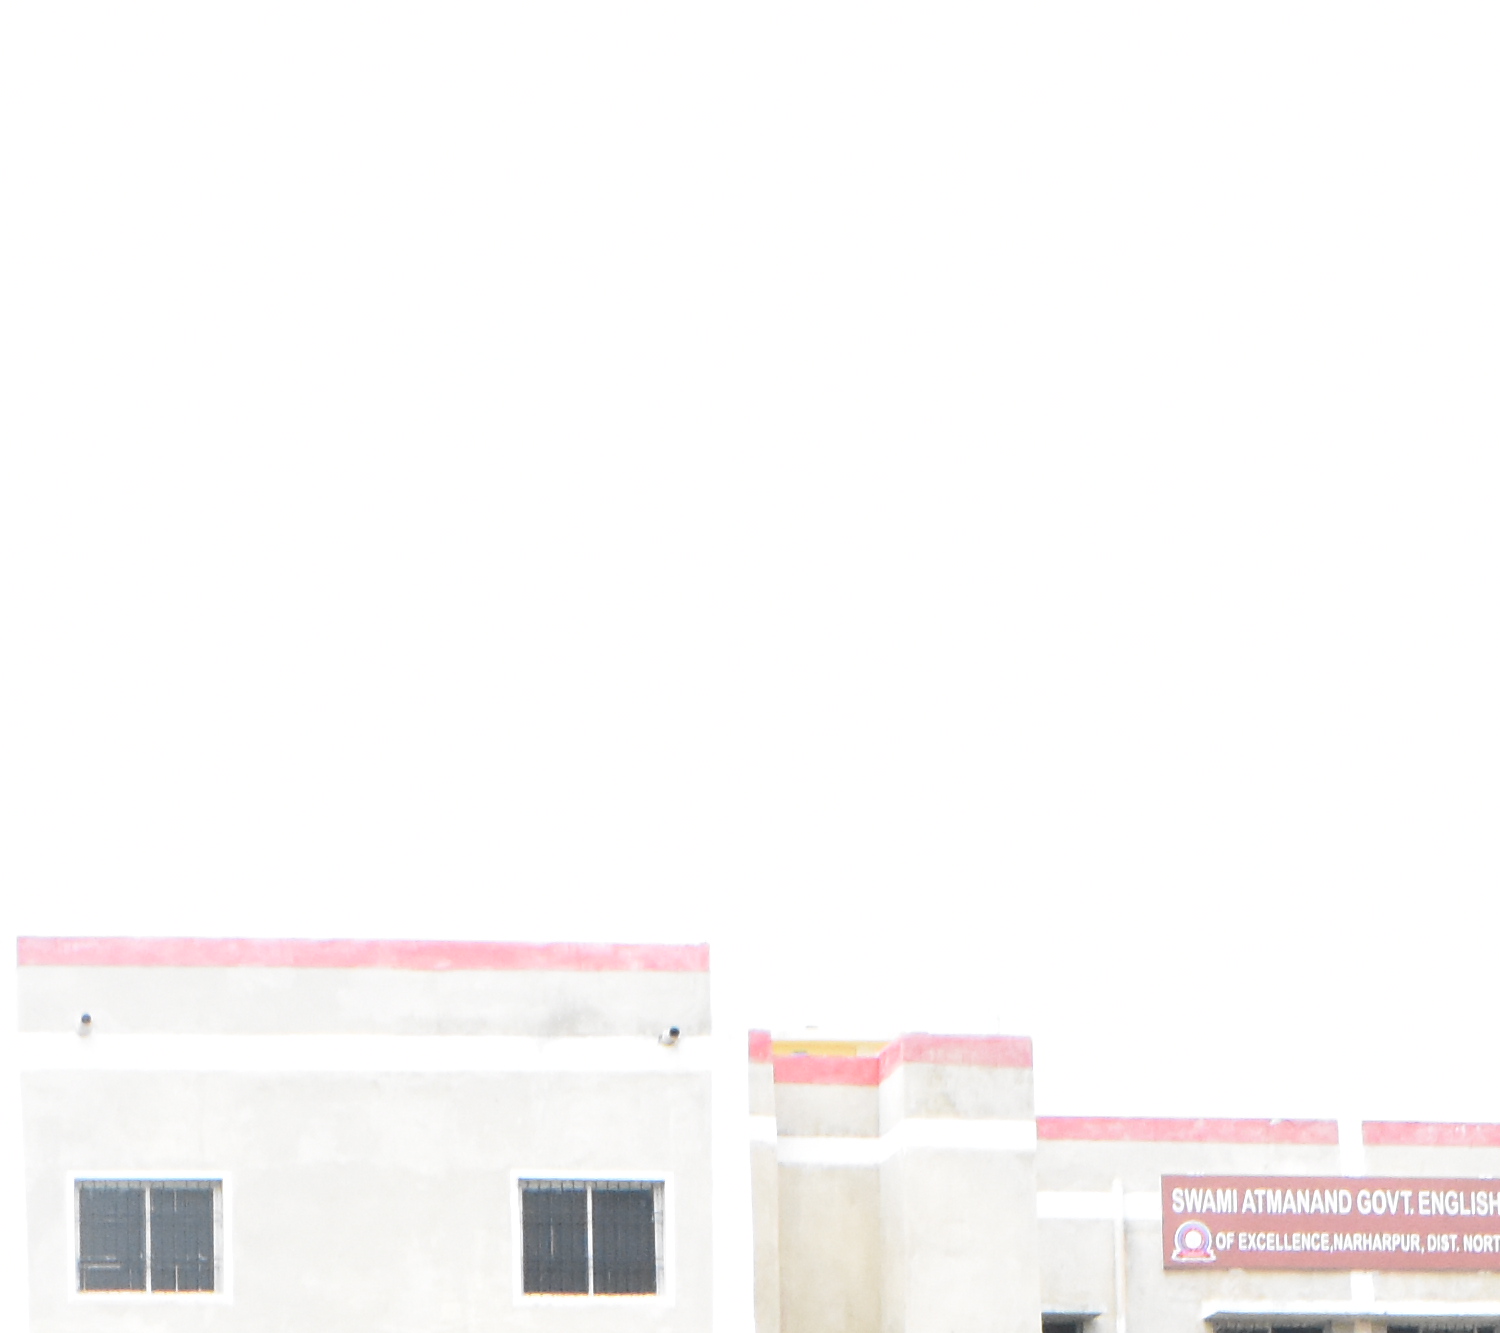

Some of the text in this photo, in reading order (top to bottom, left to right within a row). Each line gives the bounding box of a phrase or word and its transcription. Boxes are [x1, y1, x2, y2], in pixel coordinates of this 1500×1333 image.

[1172, 1188, 1238, 1214] SWAMI
[1242, 1189, 1353, 1216] ATMANAND
[1357, 1190, 1415, 1216] GOVT.
[1215, 1234, 1235, 1251] OF
[1427, 1235, 1460, 1252] DIST.
